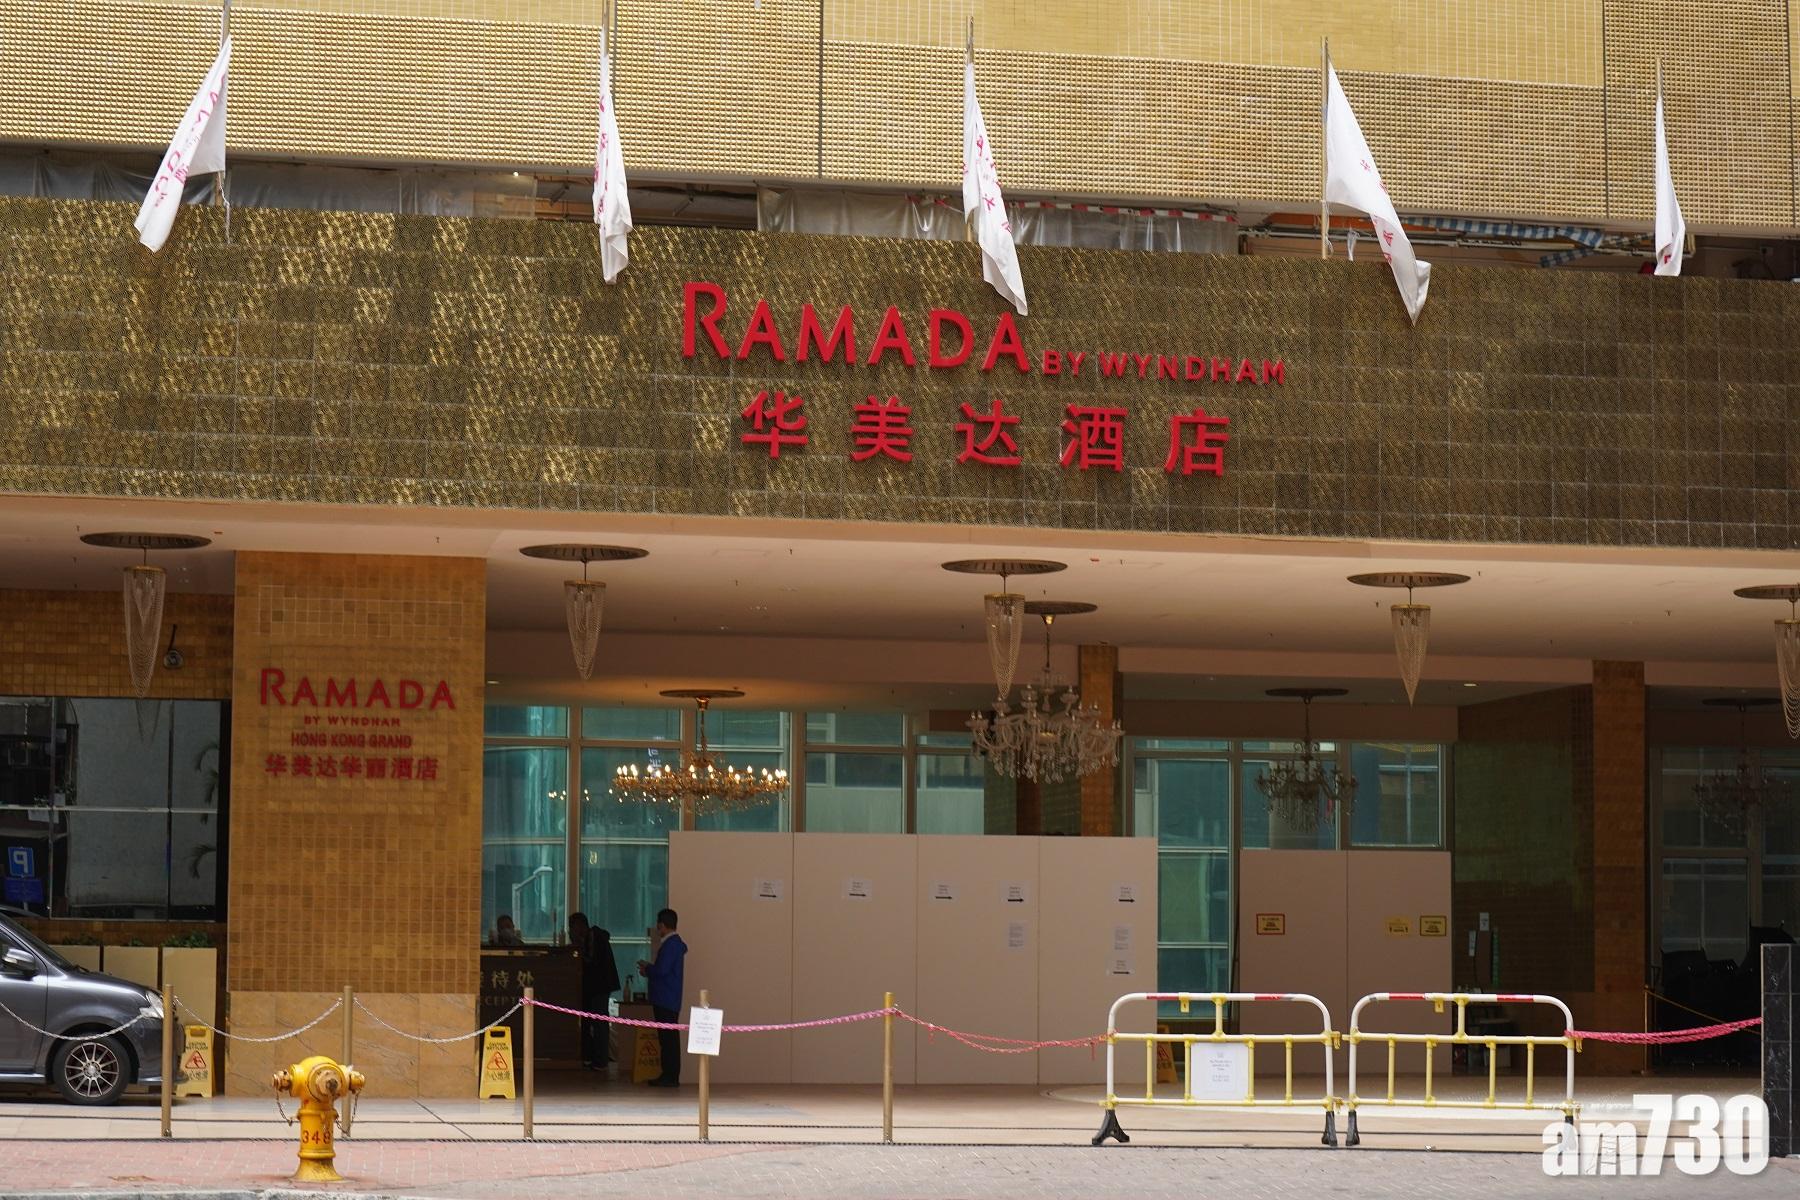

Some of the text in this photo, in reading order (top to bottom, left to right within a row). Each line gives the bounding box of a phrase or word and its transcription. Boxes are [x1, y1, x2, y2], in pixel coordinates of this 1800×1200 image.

[682, 281, 1286, 386] RAMADA BY WYNDHAM
[741, 390, 1231, 477] 华美达酒店
[260, 667, 456, 711] RAMADA
[304, 715, 401, 727] BY WYNDHAM
[291, 732, 413, 749] HONG KONG GRAND
[302, 1130, 332, 1145] 348
